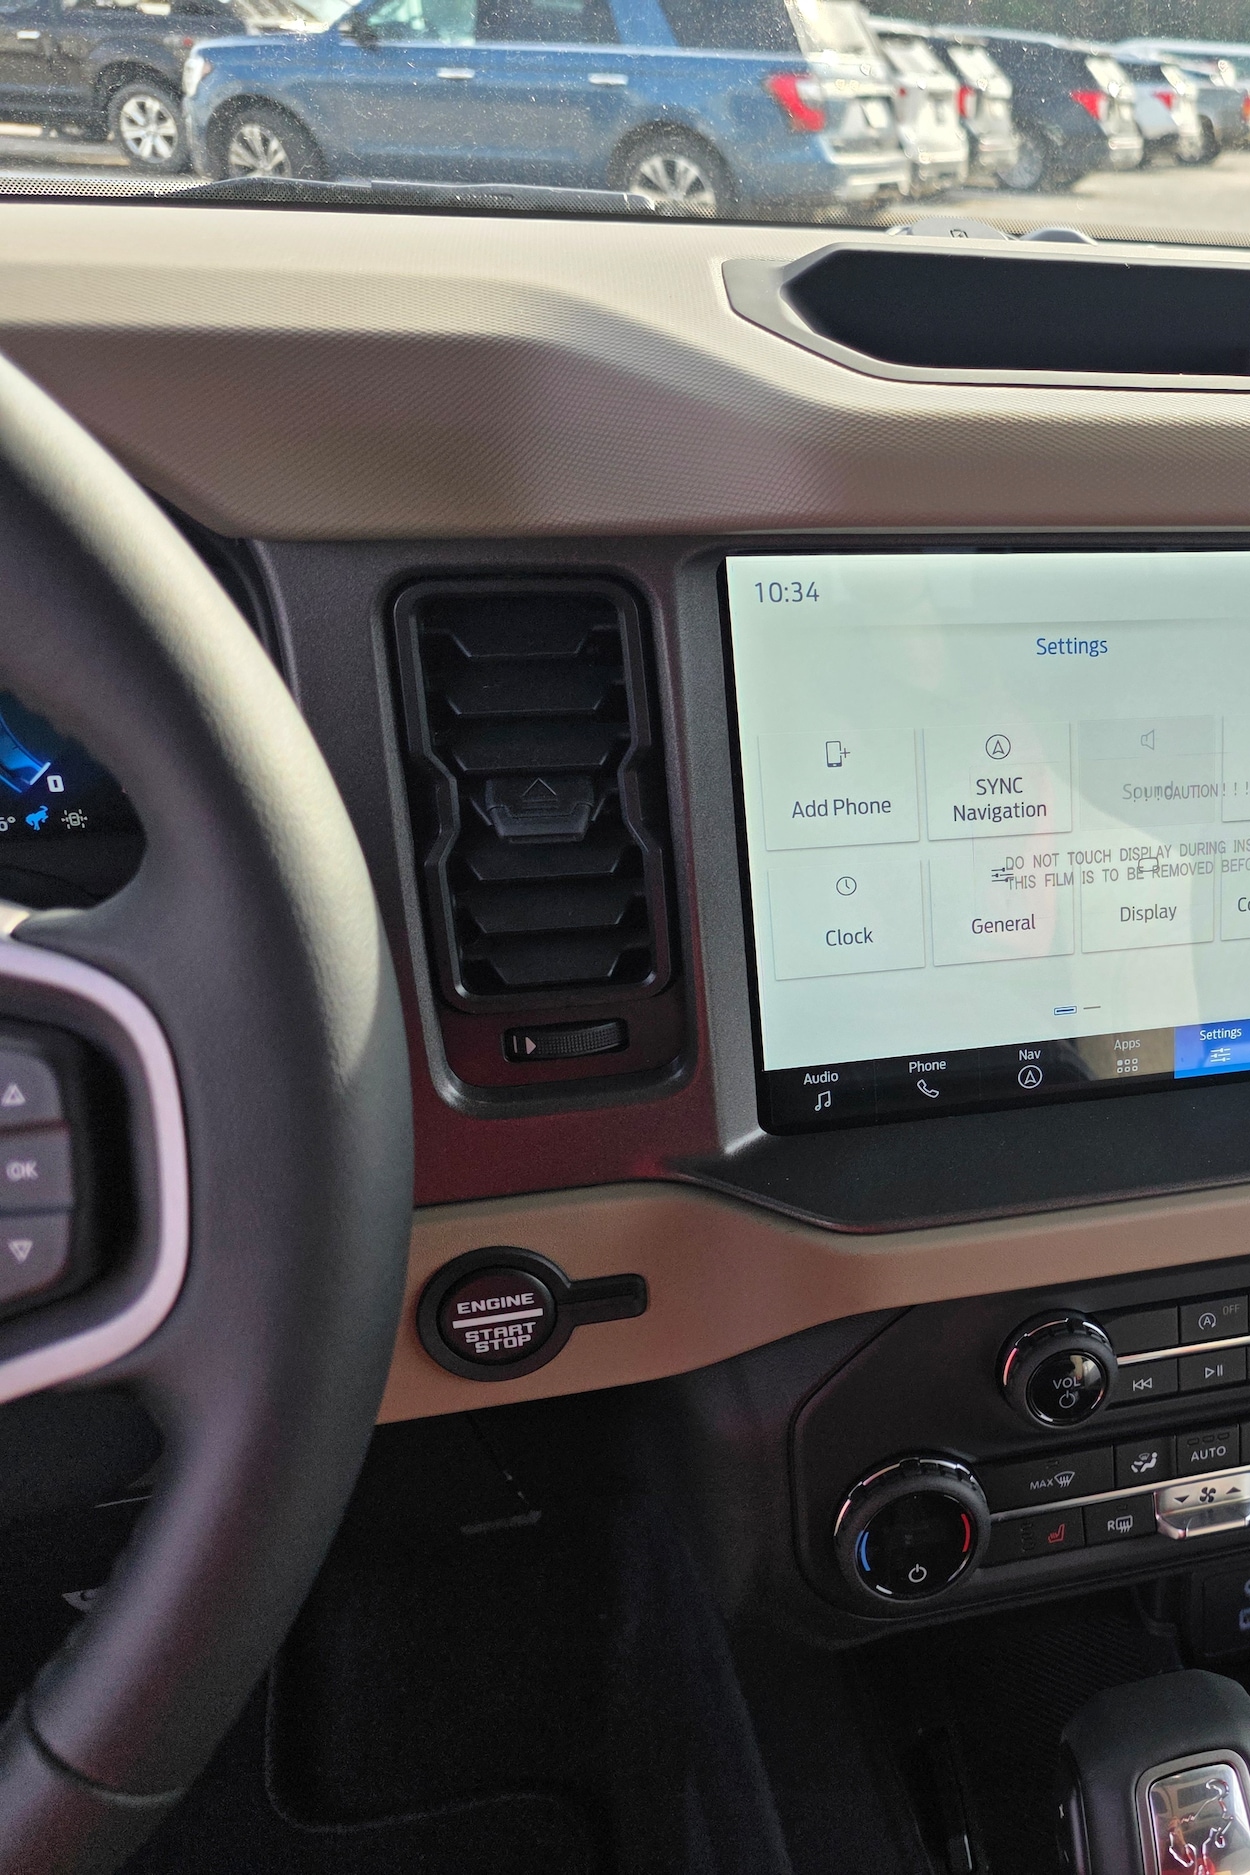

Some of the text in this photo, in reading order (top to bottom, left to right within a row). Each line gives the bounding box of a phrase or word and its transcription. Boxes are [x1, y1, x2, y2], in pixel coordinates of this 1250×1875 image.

[754, 581, 820, 604] 10:34
[1036, 637, 1109, 657] Settings
[975, 776, 1024, 796] SYNC
[791, 798, 892, 819] Add Phone
[953, 802, 1048, 823] Navigation
[1005, 855, 1025, 871] DO
[1033, 853, 1060, 869] NOT
[1067, 850, 1112, 866] TOUCH
[1119, 844, 1173, 862] DISPLAY
[1179, 840, 1227, 858] DURING
[1006, 873, 1037, 891] THIS
[1044, 870, 1075, 889] FILM
[1081, 869, 1095, 886] IS
[1102, 867, 1119, 883] TO
[1127, 863, 1145, 881] BE
[1152, 860, 1214, 879] REMOVED
[970, 913, 1036, 934] General
[1119, 904, 1178, 925] Display
[825, 926, 874, 947] Clock
[1113, 1037, 1141, 1052] Apps
[1199, 1027, 1242, 1042] Settings
[1018, 1048, 1042, 1061] Nav
[908, 1058, 947, 1074] Phone
[803, 1070, 839, 1085] Audio
[6, 1160, 38, 1182] OK
[457, 1293, 535, 1315] ENGINE
[1223, 1304, 1240, 1316] OFF
[465, 1322, 537, 1343] START
[475, 1334, 532, 1354] STOP
[1053, 1378, 1081, 1390] VOL
[1190, 1445, 1227, 1463] AUTO
[1030, 1479, 1054, 1491] MAX
[1107, 1519, 1116, 1532] R
